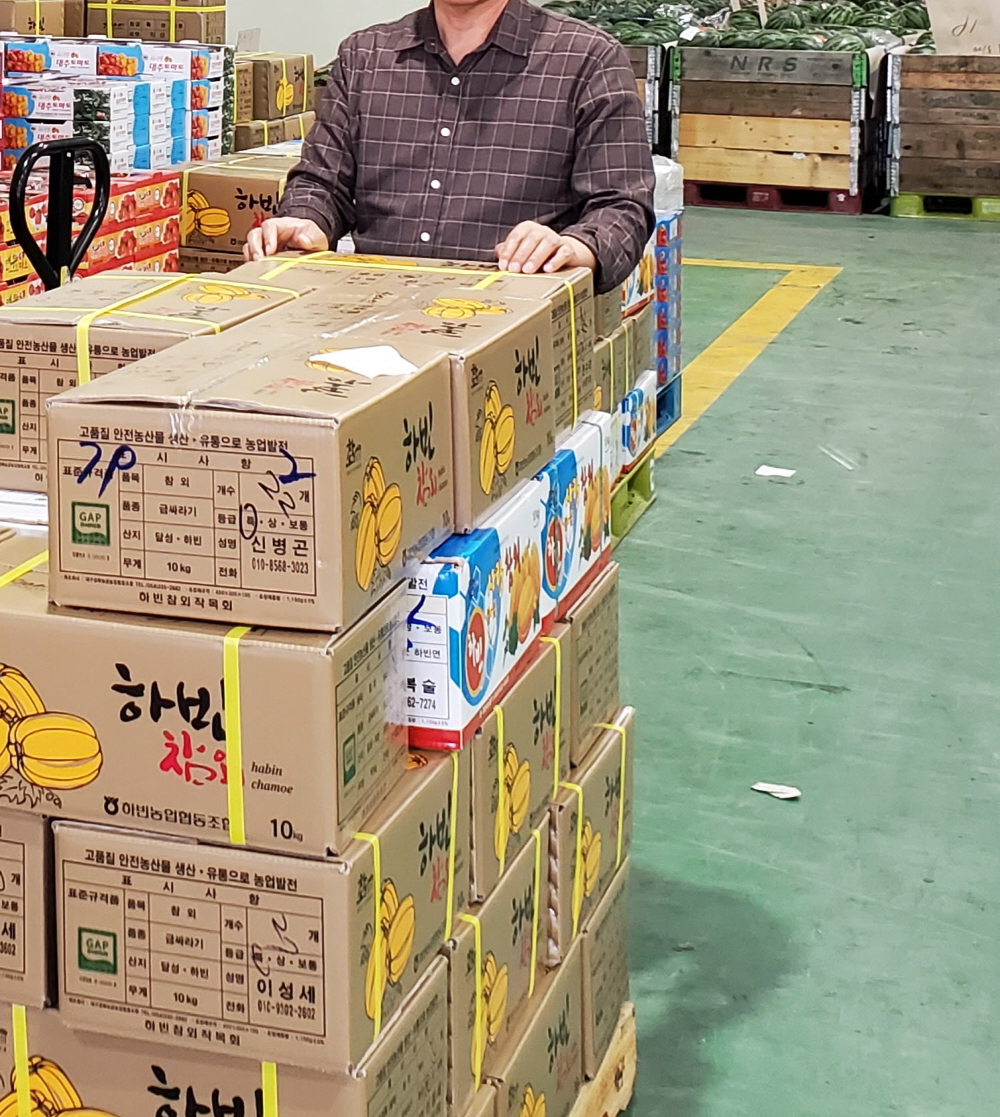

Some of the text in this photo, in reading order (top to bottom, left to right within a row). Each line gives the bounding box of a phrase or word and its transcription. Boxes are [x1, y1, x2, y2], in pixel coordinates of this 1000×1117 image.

[16, 340, 57, 353] 안전농산물
[60, 343, 76, 354] 생산
[514, 335, 540, 396] 하빈
[79, 426, 288, 452] 고품질 안전농산물 생산 유통으로 농업발전
[403, 401, 435, 472] 하빈
[217, 484, 236, 495] 개수
[79, 511, 102, 522] GAP
[218, 566, 237, 578] 전화
[251, 558, 309, 574] 010-8568-3023
[251, 761, 283, 777] habin
[251, 781, 293, 795] chamoe
[84, 849, 298, 892] 고품질 안전농산물 생산 유통으로 농업발전
[86, 938, 109, 949] GAP
